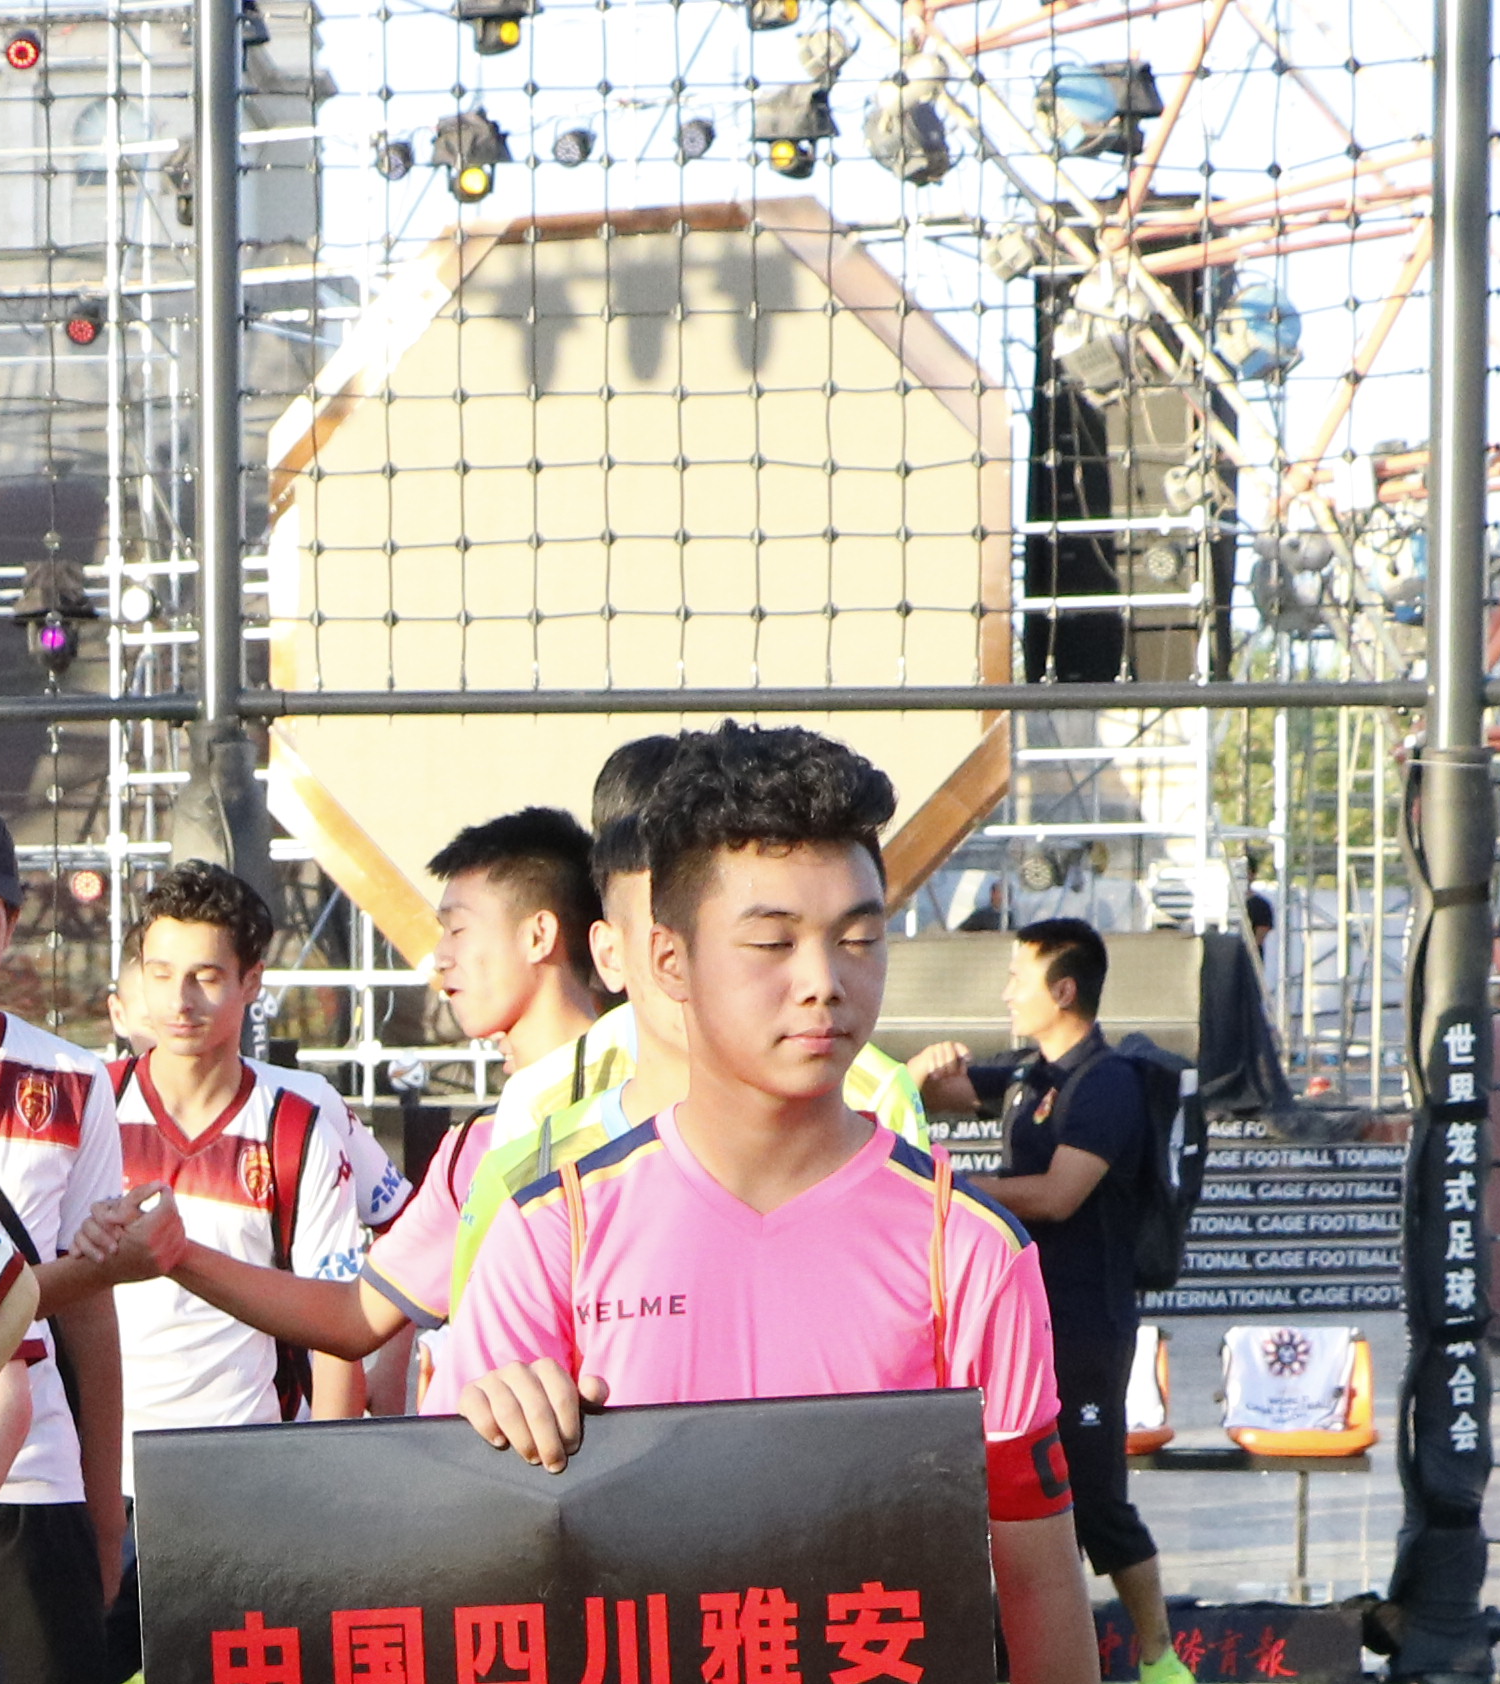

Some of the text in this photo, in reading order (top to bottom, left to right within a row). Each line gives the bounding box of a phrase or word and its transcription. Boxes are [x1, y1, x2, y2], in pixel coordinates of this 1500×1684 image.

[1244, 1150, 1331, 1167] FOOTBALL
[1257, 1183, 1305, 1199] CAGE
[1307, 1181, 1398, 1198] FOOTBALL
[1255, 1216, 1306, 1232] CAGE
[1308, 1214, 1401, 1231] FOOTBALL
[1254, 1250, 1305, 1268] CAGE
[1144, 1289, 1296, 1309] INTERNATIONAL
[1298, 1286, 1350, 1305] CAGE
[576, 1293, 687, 1325] KELME
